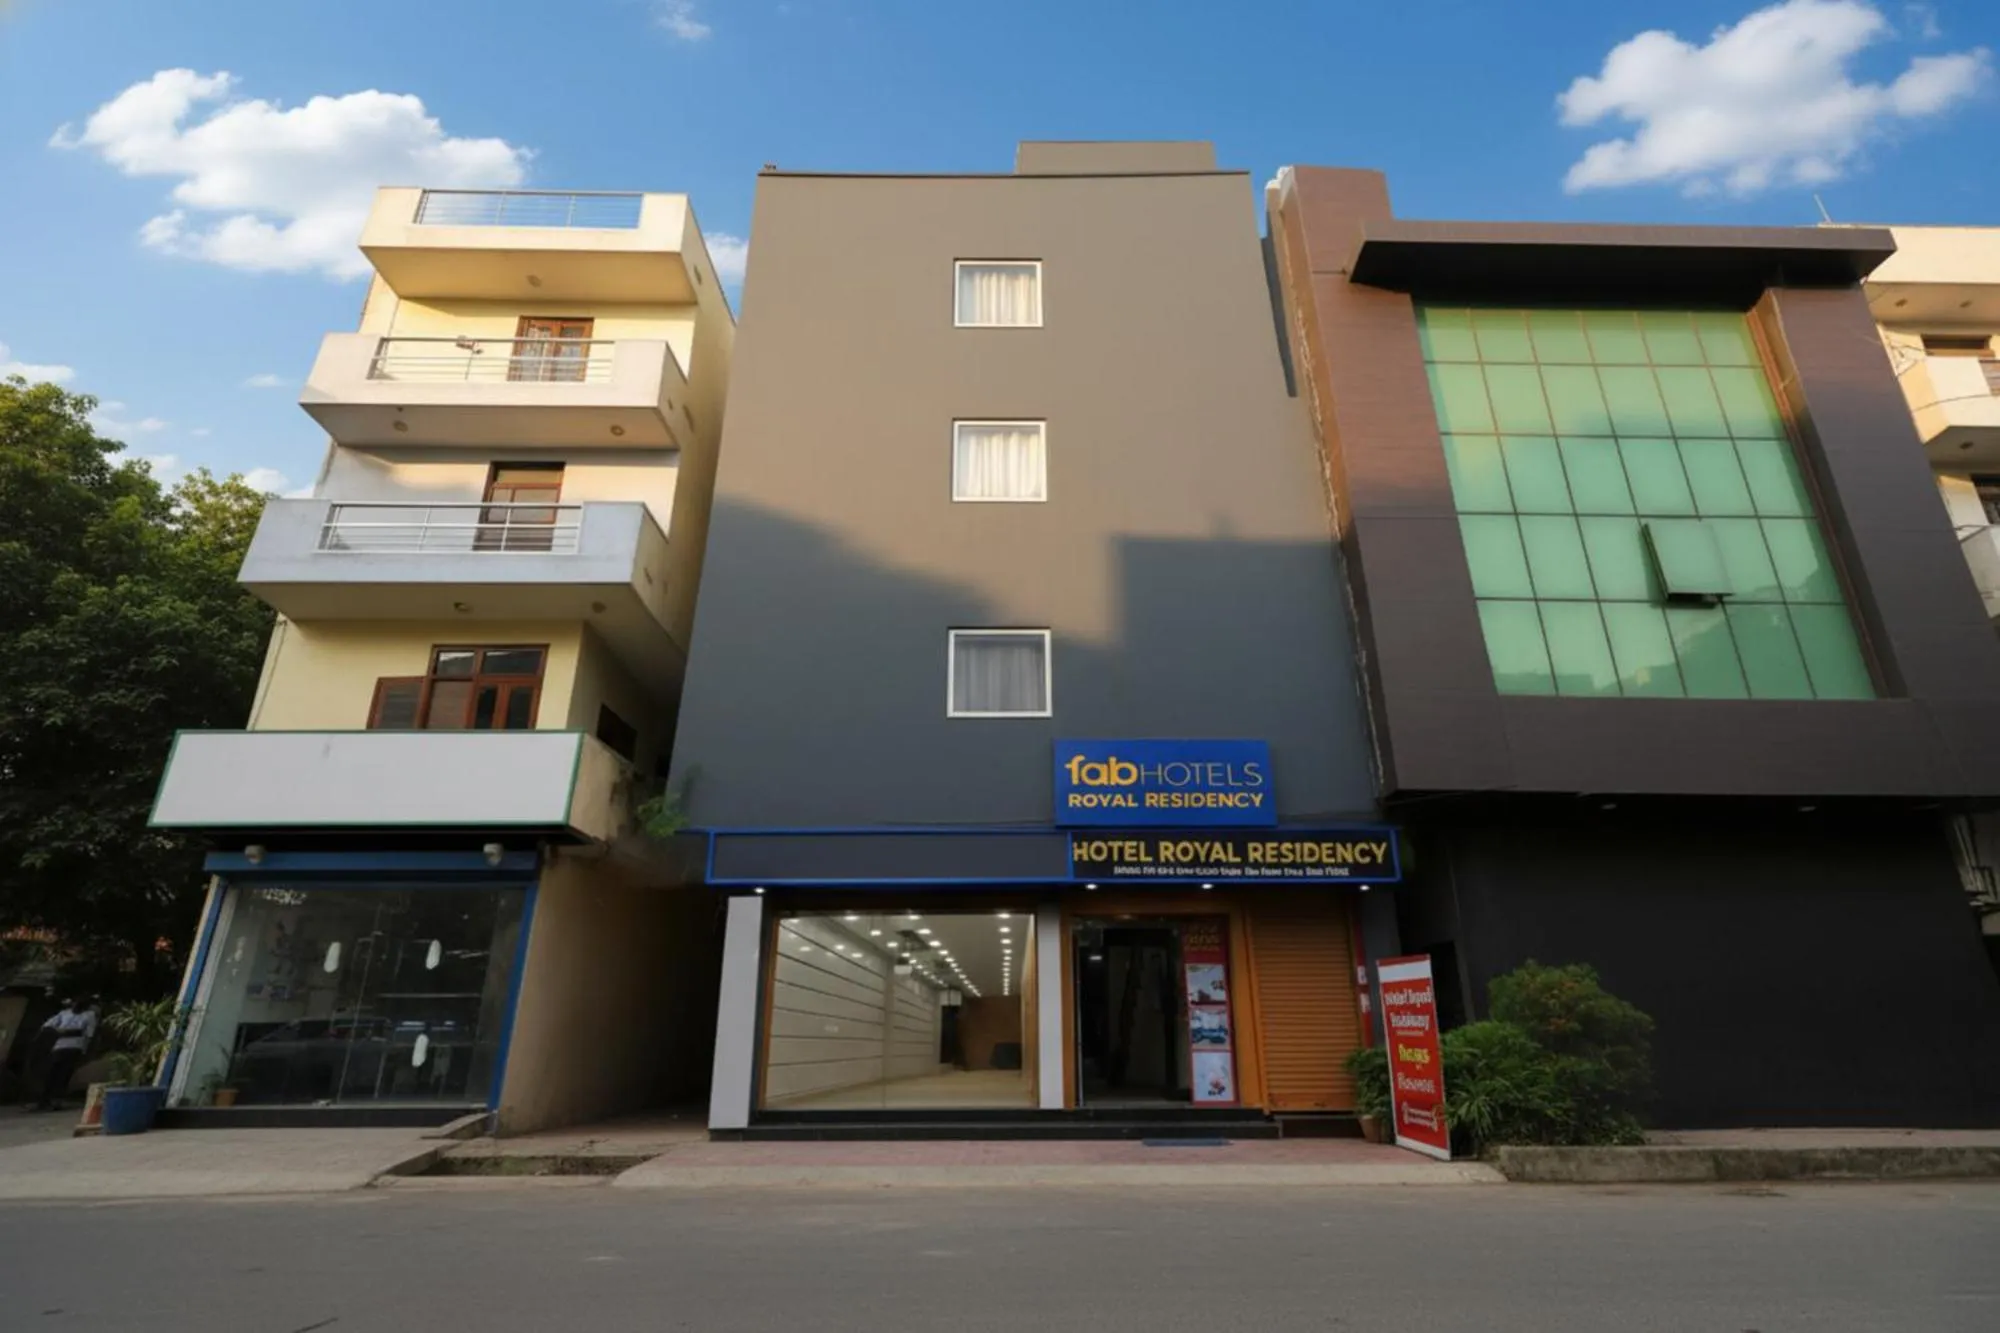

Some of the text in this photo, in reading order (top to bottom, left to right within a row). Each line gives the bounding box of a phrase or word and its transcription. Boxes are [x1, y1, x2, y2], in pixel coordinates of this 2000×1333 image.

[1068, 792, 1264, 808] ROYAL RESIDENCY
[1073, 841, 1388, 864] HOTEL ROYAL RESIDENCY
